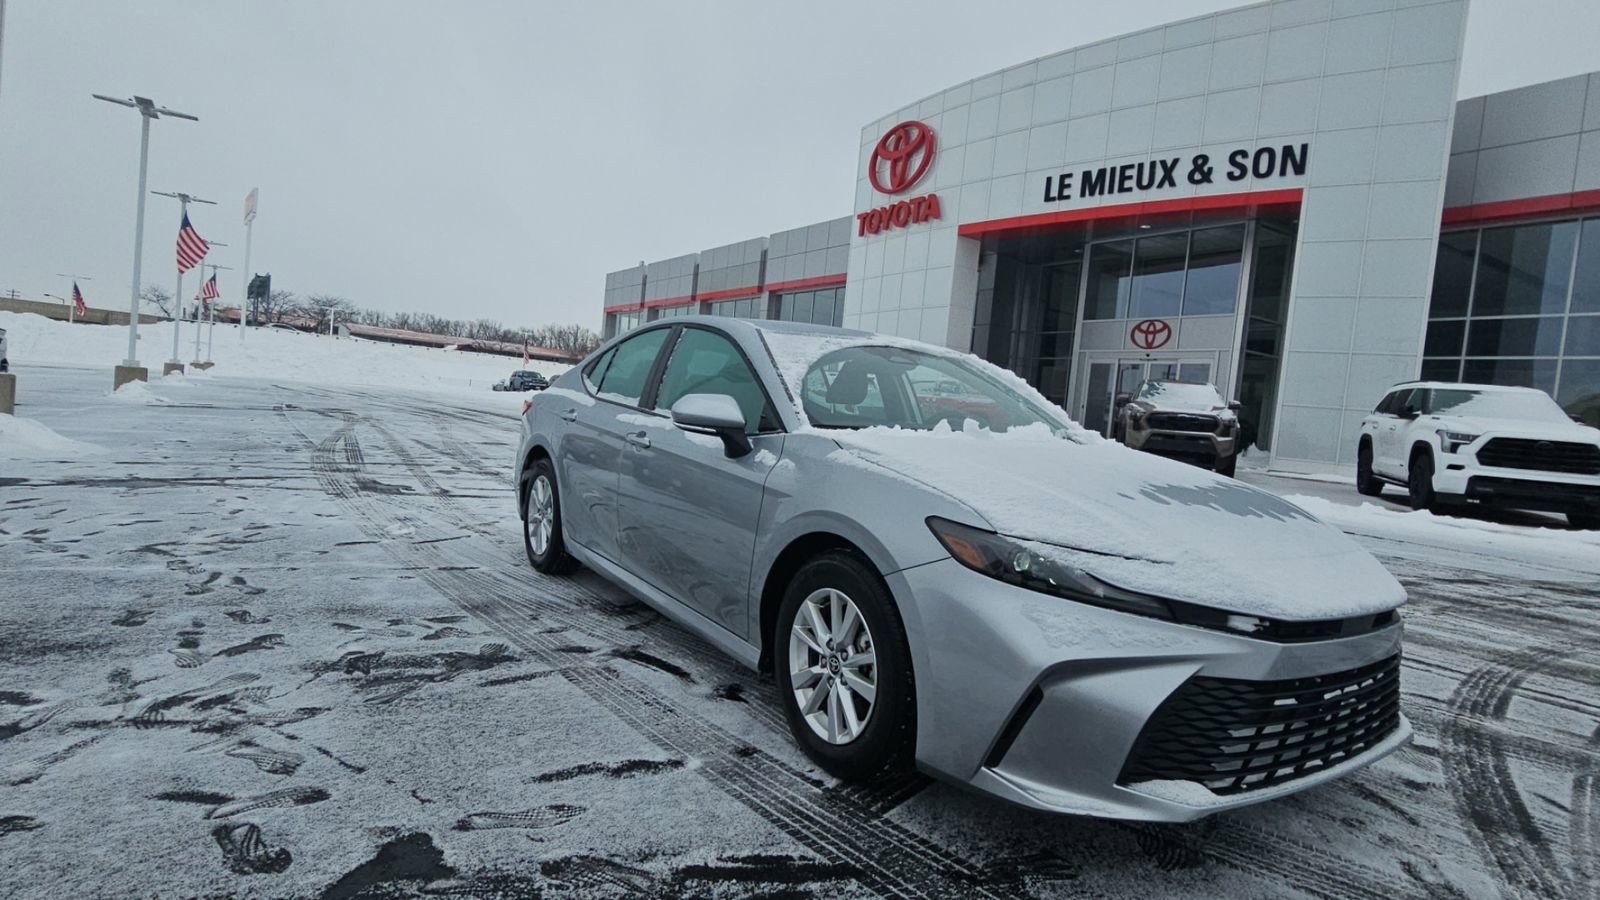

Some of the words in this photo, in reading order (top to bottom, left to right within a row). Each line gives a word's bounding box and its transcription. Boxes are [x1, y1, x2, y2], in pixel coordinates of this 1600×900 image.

[1044, 173, 1073, 202] LE
[1080, 158, 1180, 198] MIEUX
[1187, 154, 1213, 185] &
[1227, 143, 1309, 181] SON
[857, 194, 941, 237] TOYOTA
